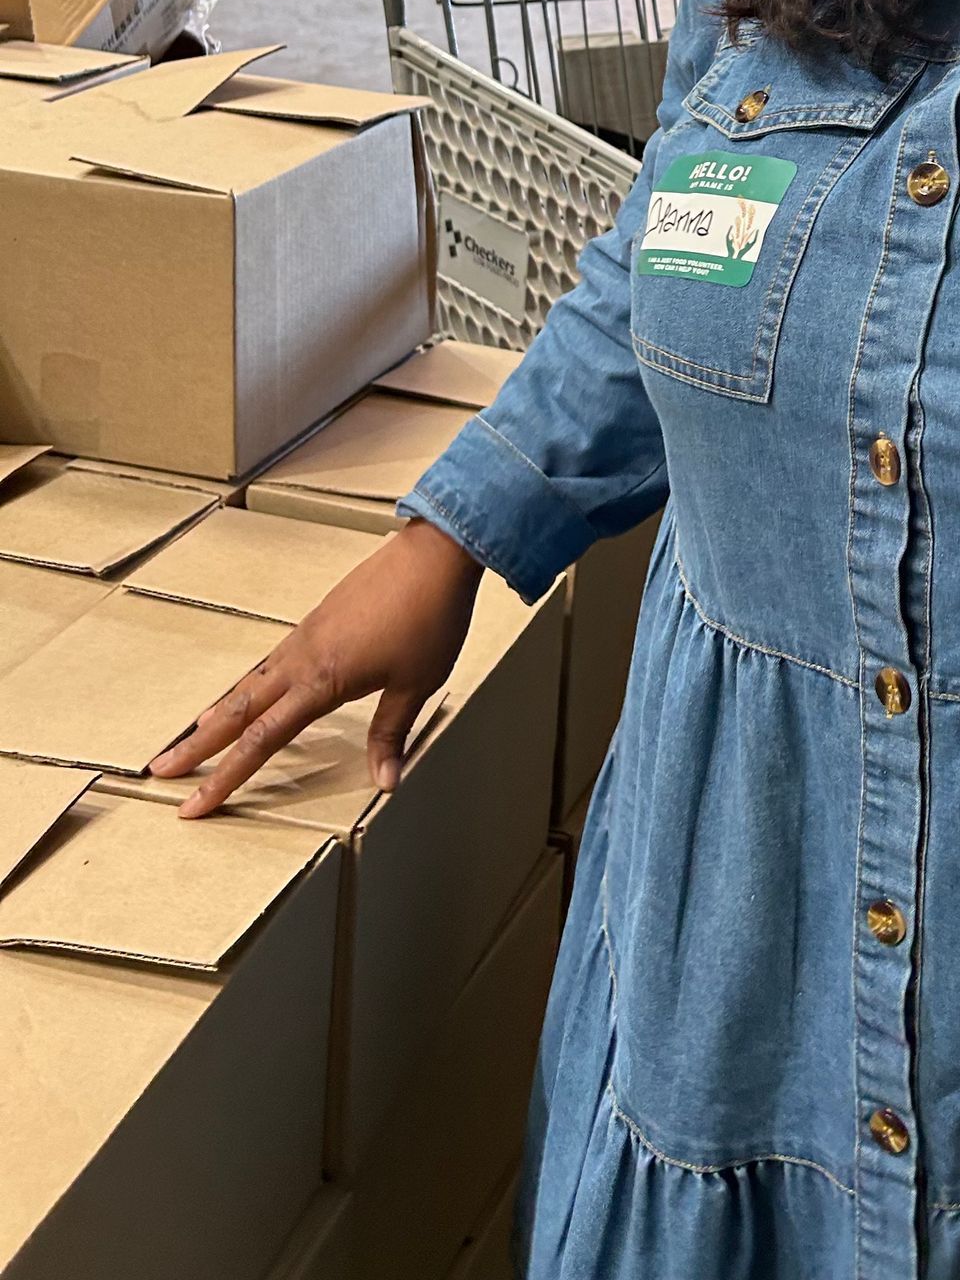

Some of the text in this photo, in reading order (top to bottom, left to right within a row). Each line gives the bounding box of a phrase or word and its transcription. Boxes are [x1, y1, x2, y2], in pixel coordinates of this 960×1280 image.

[689, 162, 752, 182] HELLO!
[699, 181, 724, 190] NAME
[724, 183, 734, 191] IS
[464, 235, 515, 276] Checkers
